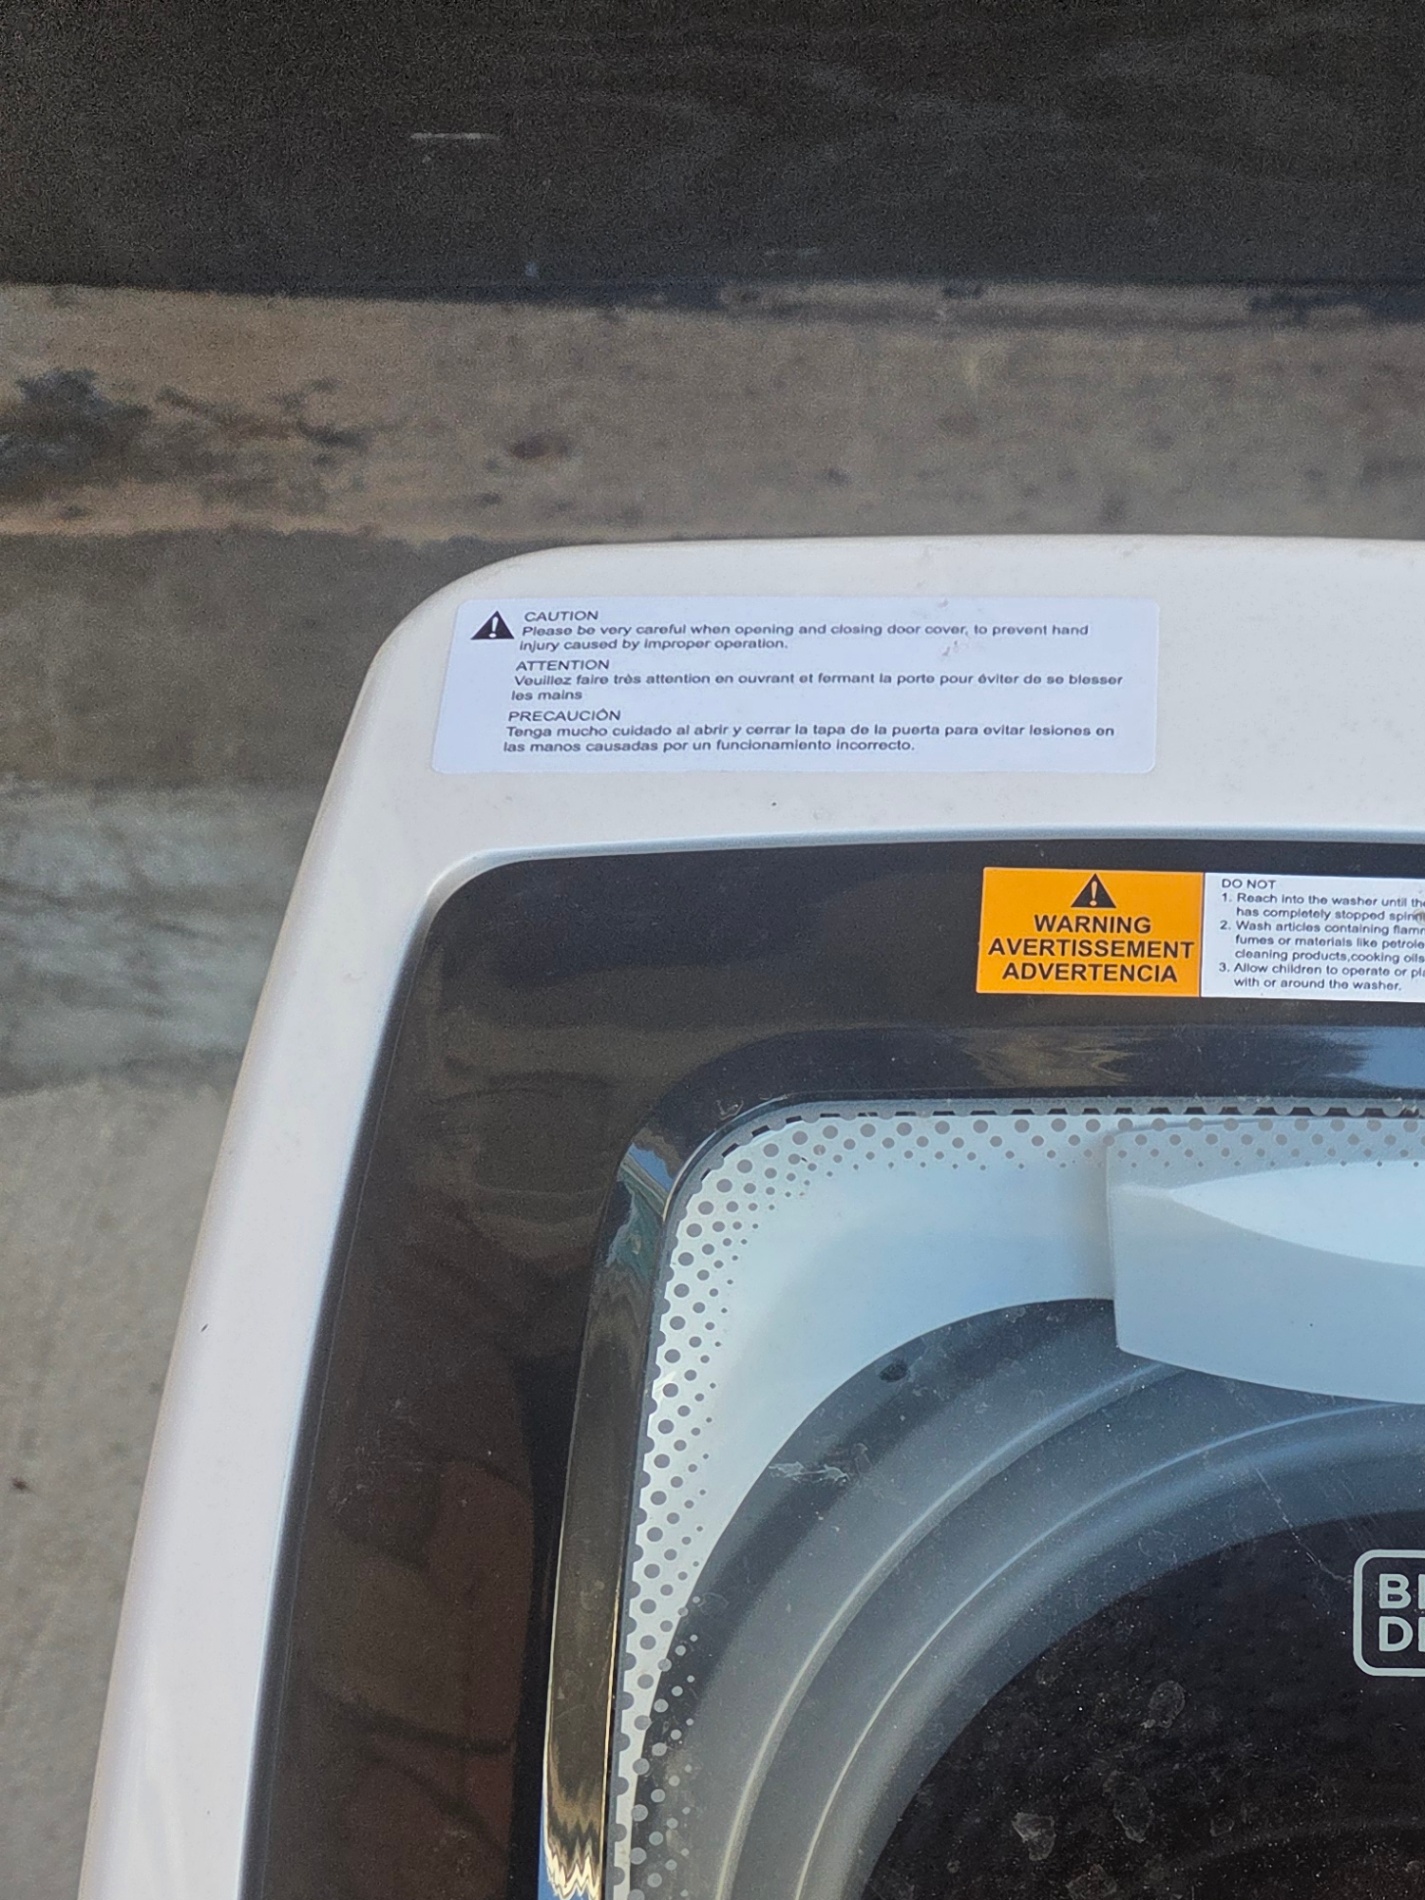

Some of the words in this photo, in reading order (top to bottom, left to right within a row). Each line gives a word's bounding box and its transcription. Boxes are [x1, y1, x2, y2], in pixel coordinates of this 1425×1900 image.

[524, 611, 599, 623] CAUTION
[522, 625, 573, 637] Please
[577, 625, 596, 636] be
[600, 625, 631, 638] very
[636, 624, 686, 635] careful
[691, 624, 730, 635] when
[734, 624, 793, 637] opening
[798, 624, 826, 635] and
[830, 624, 882, 637] closing
[887, 624, 921, 635] door
[924, 625, 969, 637] cover,
[973, 625, 988, 636] to
[992, 625, 1048, 638] prevent
[1052, 624, 1089, 636] hand
[519, 640, 560, 653] injury
[563, 639, 618, 650] caused
[622, 639, 640, 652] by
[644, 639, 711, 651] improper
[715, 639, 789, 650] operation.
[515, 660, 610, 672] ATTENTION
[514, 675, 572, 686] Veuillez
[576, 675, 609, 685] faire
[613, 674, 641, 685] très
[646, 673, 710, 684] attention
[715, 674, 734, 683] en
[738, 673, 795, 683] ouvrant
[799, 674, 814, 683] et
[818, 673, 875, 683] fermant
[879, 673, 892, 683] la
[897, 674, 935, 686] porte
[939, 674, 974, 686] pour
[977, 673, 1019, 684] éviter
[1023, 674, 1042, 685] de
[1046, 675, 1064, 685] se
[1069, 674, 1123, 685] blesser
[511, 690, 533, 701] les
[537, 689, 582, 700] mains
[506, 726, 552, 738] Tenga
[556, 725, 608, 737] mucho
[612, 725, 672, 736] cuidado
[676, 724, 690, 736] al
[694, 724, 729, 736] abrir
[733, 725, 742, 737] y
[746, 724, 791, 735] cerrar
[795, 724, 808, 735] la
[813, 724, 846, 737] tapa
[850, 724, 869, 735] de
[874, 724, 887, 735] la
[892, 725, 940, 737] puerta
[945, 725, 978, 737] para
[983, 724, 1025, 736] evitar
[1029, 725, 1091, 737] lesiones
[1095, 726, 1114, 737] en
[503, 742, 526, 752] las
[530, 742, 581, 752] manos
[586, 741, 658, 752] causadas
[663, 741, 689, 753] por
[693, 741, 712, 751] un
[716, 739, 831, 751] funcionamiento
[836, 740, 915, 751] incorrecto.
[1221, 879, 1242, 889] DO
[1246, 879, 1277, 890] NOT
[1237, 893, 1277, 904] Reach
[1282, 894, 1305, 905] into
[1308, 895, 1328, 905] the
[1332, 896, 1377, 906] washer
[1382, 897, 1407, 907] until
[1236, 907, 1259, 918] has
[1263, 909, 1331, 921] completely
[1335, 910, 1385, 923] stopped
[1034, 914, 1151, 934] WARNING
[1220, 921, 1231, 930] 2.
[1236, 921, 1272, 931] Wash
[1276, 922, 1320, 933] articles
[1324, 923, 1389, 936] containing
[987, 938, 1195, 958] AVERTISSEMENT
[1235, 934, 1274, 945] fumes
[1278, 937, 1291, 946] or
[1295, 936, 1353, 948] materials
[1356, 937, 1378, 948] like
[1235, 949, 1288, 962] cleaning
[1403, 953, 1425, 963] oils
[1002, 962, 1178, 982] ADVERTENCIA
[1219, 963, 1230, 972] 3.
[1234, 963, 1268, 974] Allow
[1272, 964, 1322, 975] children
[1326, 965, 1338, 975] to
[1342, 966, 1390, 978] operate
[1394, 968, 1407, 976] or
[1234, 977, 1259, 987] with
[1263, 979, 1277, 987] or
[1280, 978, 1325, 989] around
[1329, 979, 1349, 990] the
[1353, 980, 1402, 991] washer.
